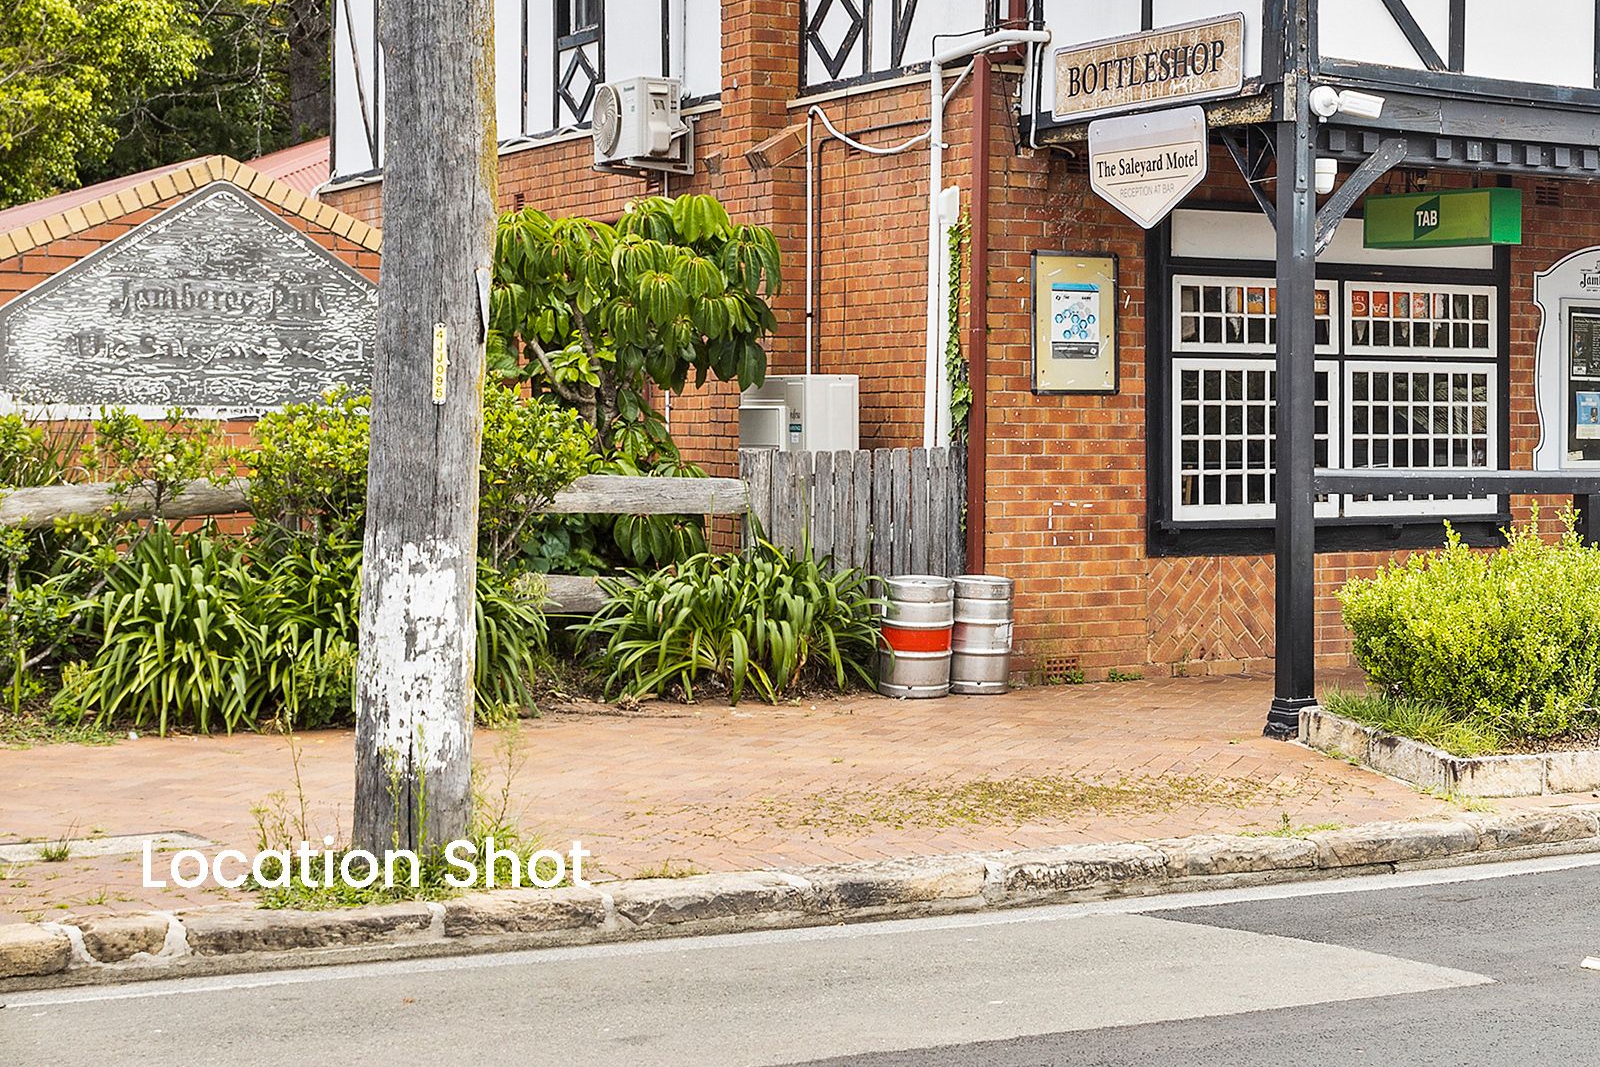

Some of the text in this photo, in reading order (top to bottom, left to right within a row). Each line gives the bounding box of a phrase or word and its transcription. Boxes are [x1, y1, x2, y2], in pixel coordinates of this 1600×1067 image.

[1068, 39, 1225, 98] BOTTLESHOP
[1096, 149, 1198, 178] The Saleyard Motel
[1120, 183, 1175, 198] RECEPTION AT BAR
[1416, 210, 1438, 227] TAB
